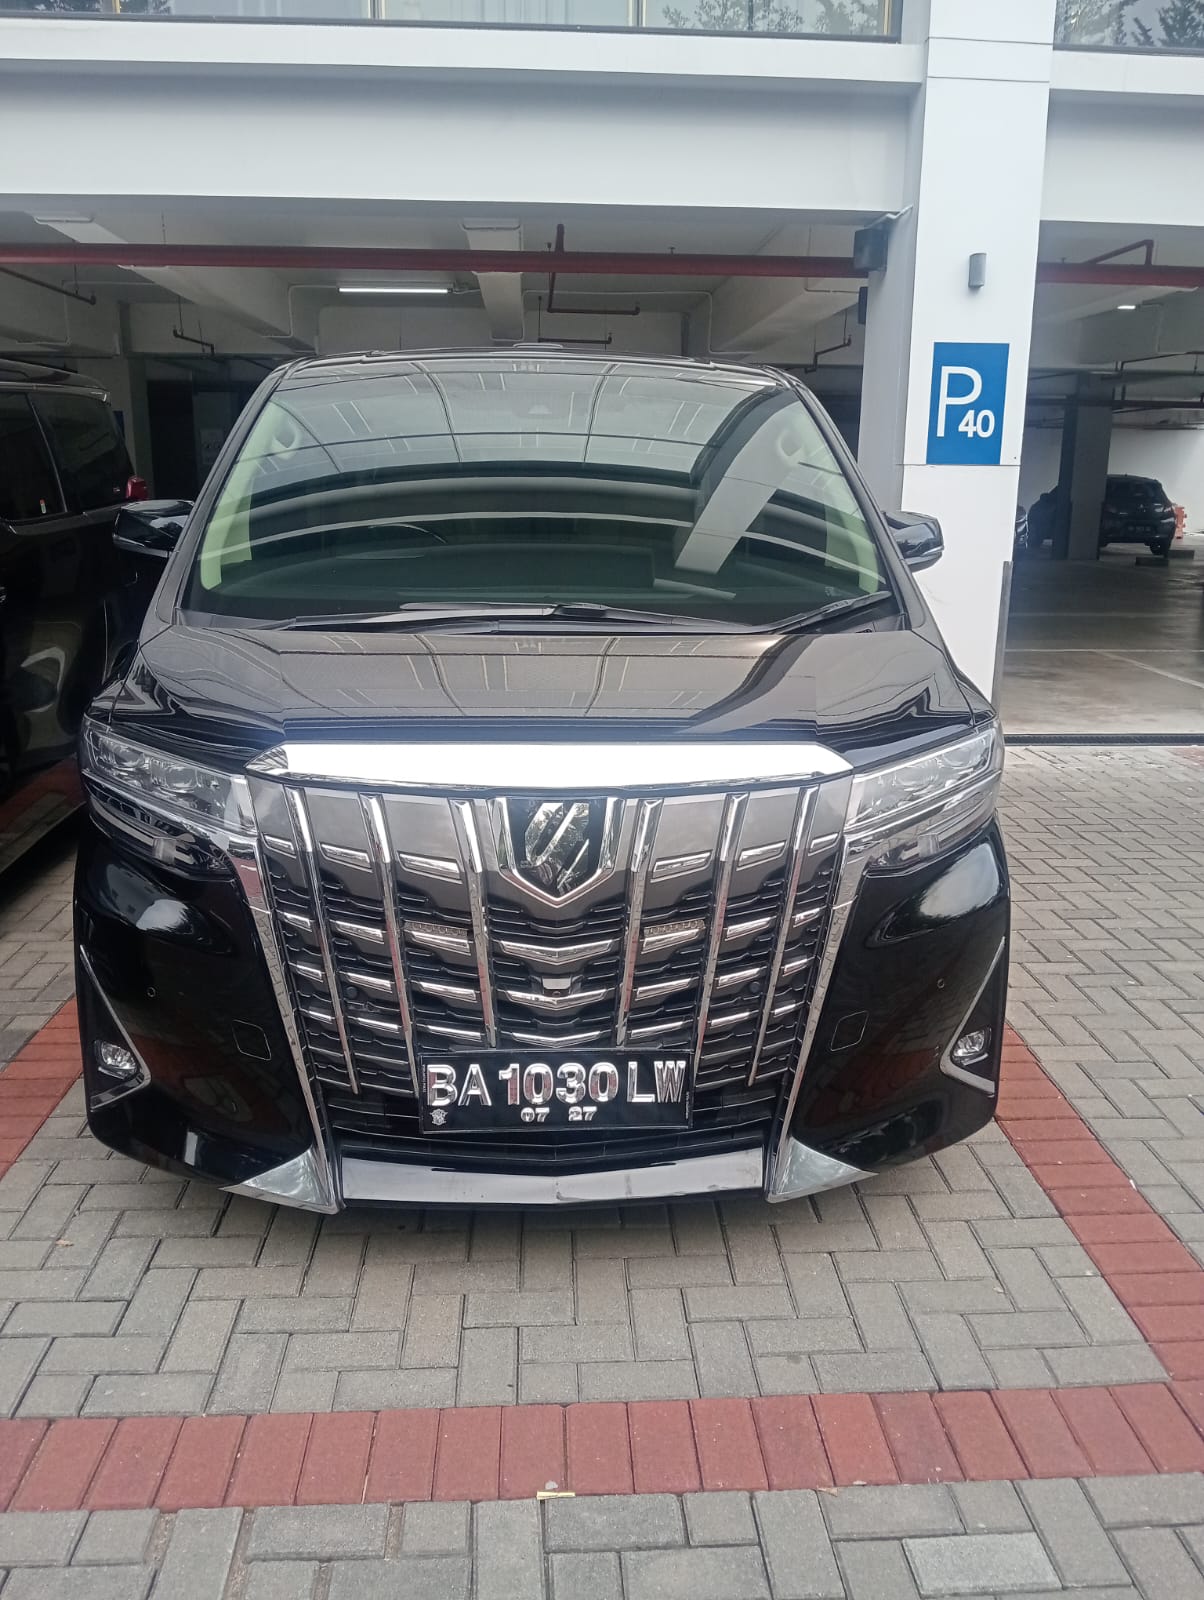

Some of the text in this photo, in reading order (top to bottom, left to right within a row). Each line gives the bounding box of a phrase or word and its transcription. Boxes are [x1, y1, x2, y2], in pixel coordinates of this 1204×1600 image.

[936, 365, 995, 438] P 40
[427, 1063, 493, 1106] BA
[499, 1062, 619, 1106] 1030
[626, 1060, 687, 1104] LW
[520, 1106, 598, 1123] 07 27
